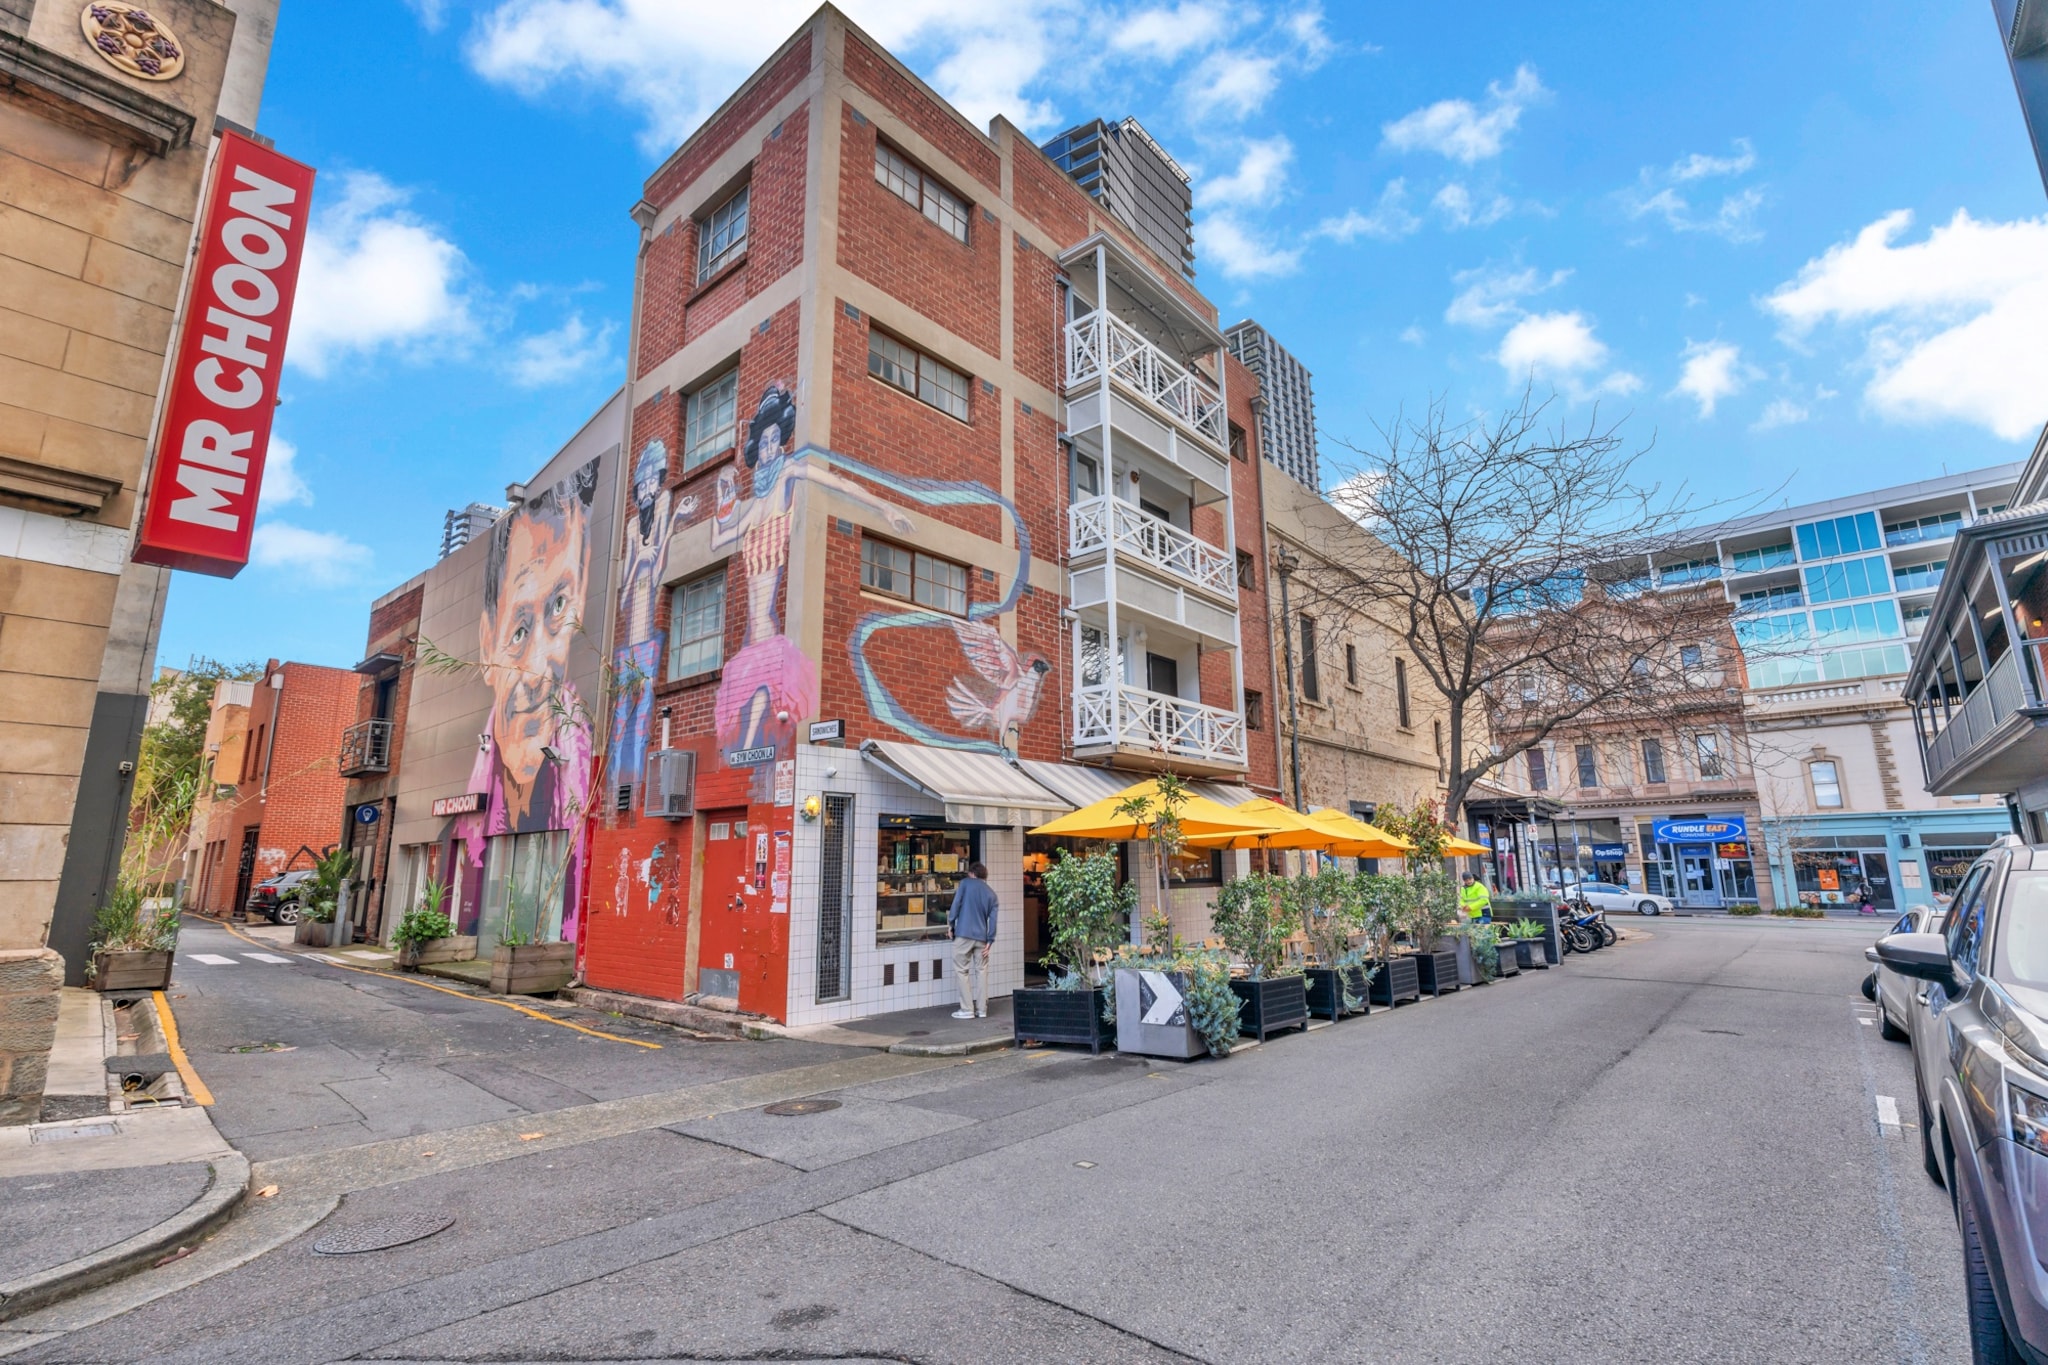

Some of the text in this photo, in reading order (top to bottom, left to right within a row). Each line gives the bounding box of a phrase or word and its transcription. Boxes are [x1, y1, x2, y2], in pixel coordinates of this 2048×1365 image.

[168, 164, 297, 533] MR CHOON
[812, 724, 837, 736] SANDWICHES
[736, 752, 747, 762] SYM
[748, 749, 766, 761] CHOON
[766, 748, 773, 758] LA
[433, 794, 477, 815] MR CHOON
[1672, 824, 1728, 833] RUNDLE EAST
